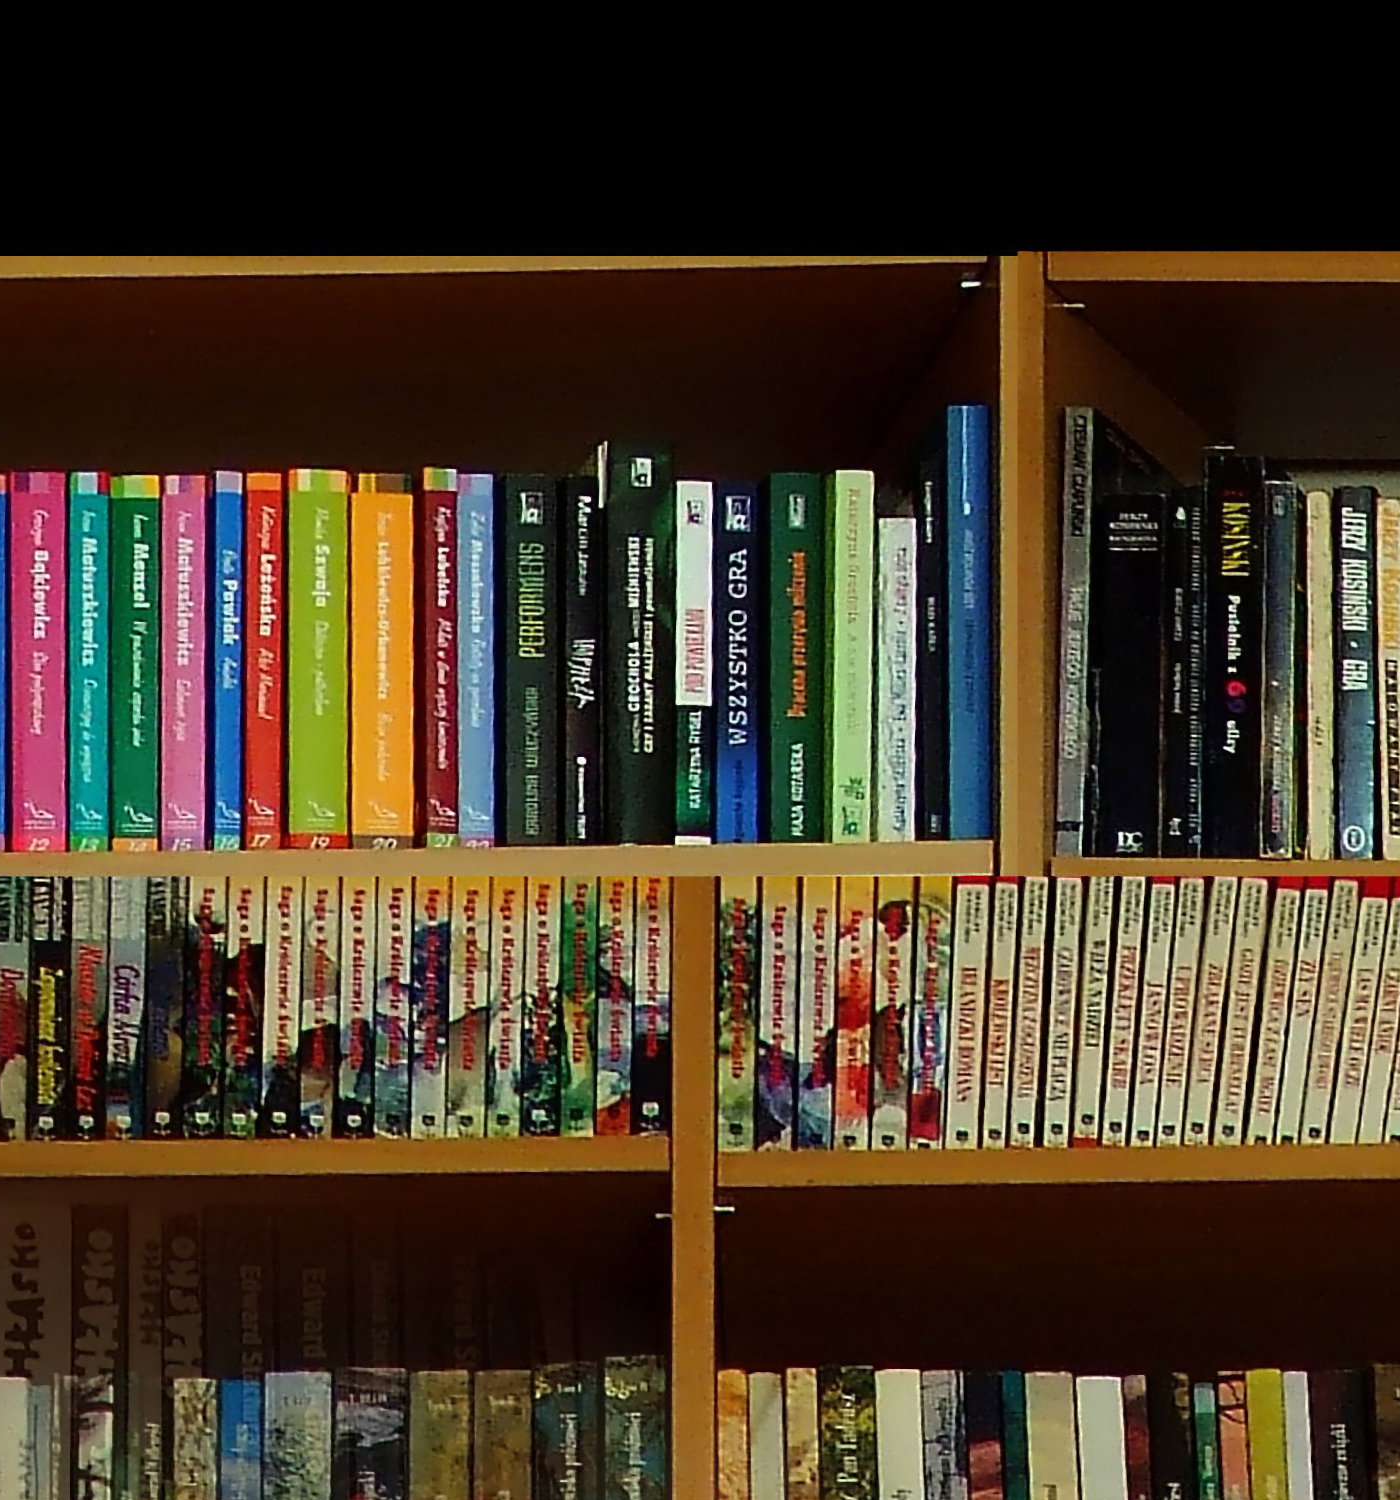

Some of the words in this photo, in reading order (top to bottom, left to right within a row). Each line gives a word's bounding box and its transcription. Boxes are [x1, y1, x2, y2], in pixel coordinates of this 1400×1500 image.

[1342, 508, 1366, 552] JERZY
[518, 542, 548, 658] PERFORMENS
[728, 549, 749, 599] GRA
[1341, 559, 1371, 631] KOSIŃSKI
[729, 611, 750, 746] WSZYSTKO
[1342, 659, 1369, 691] GRA
